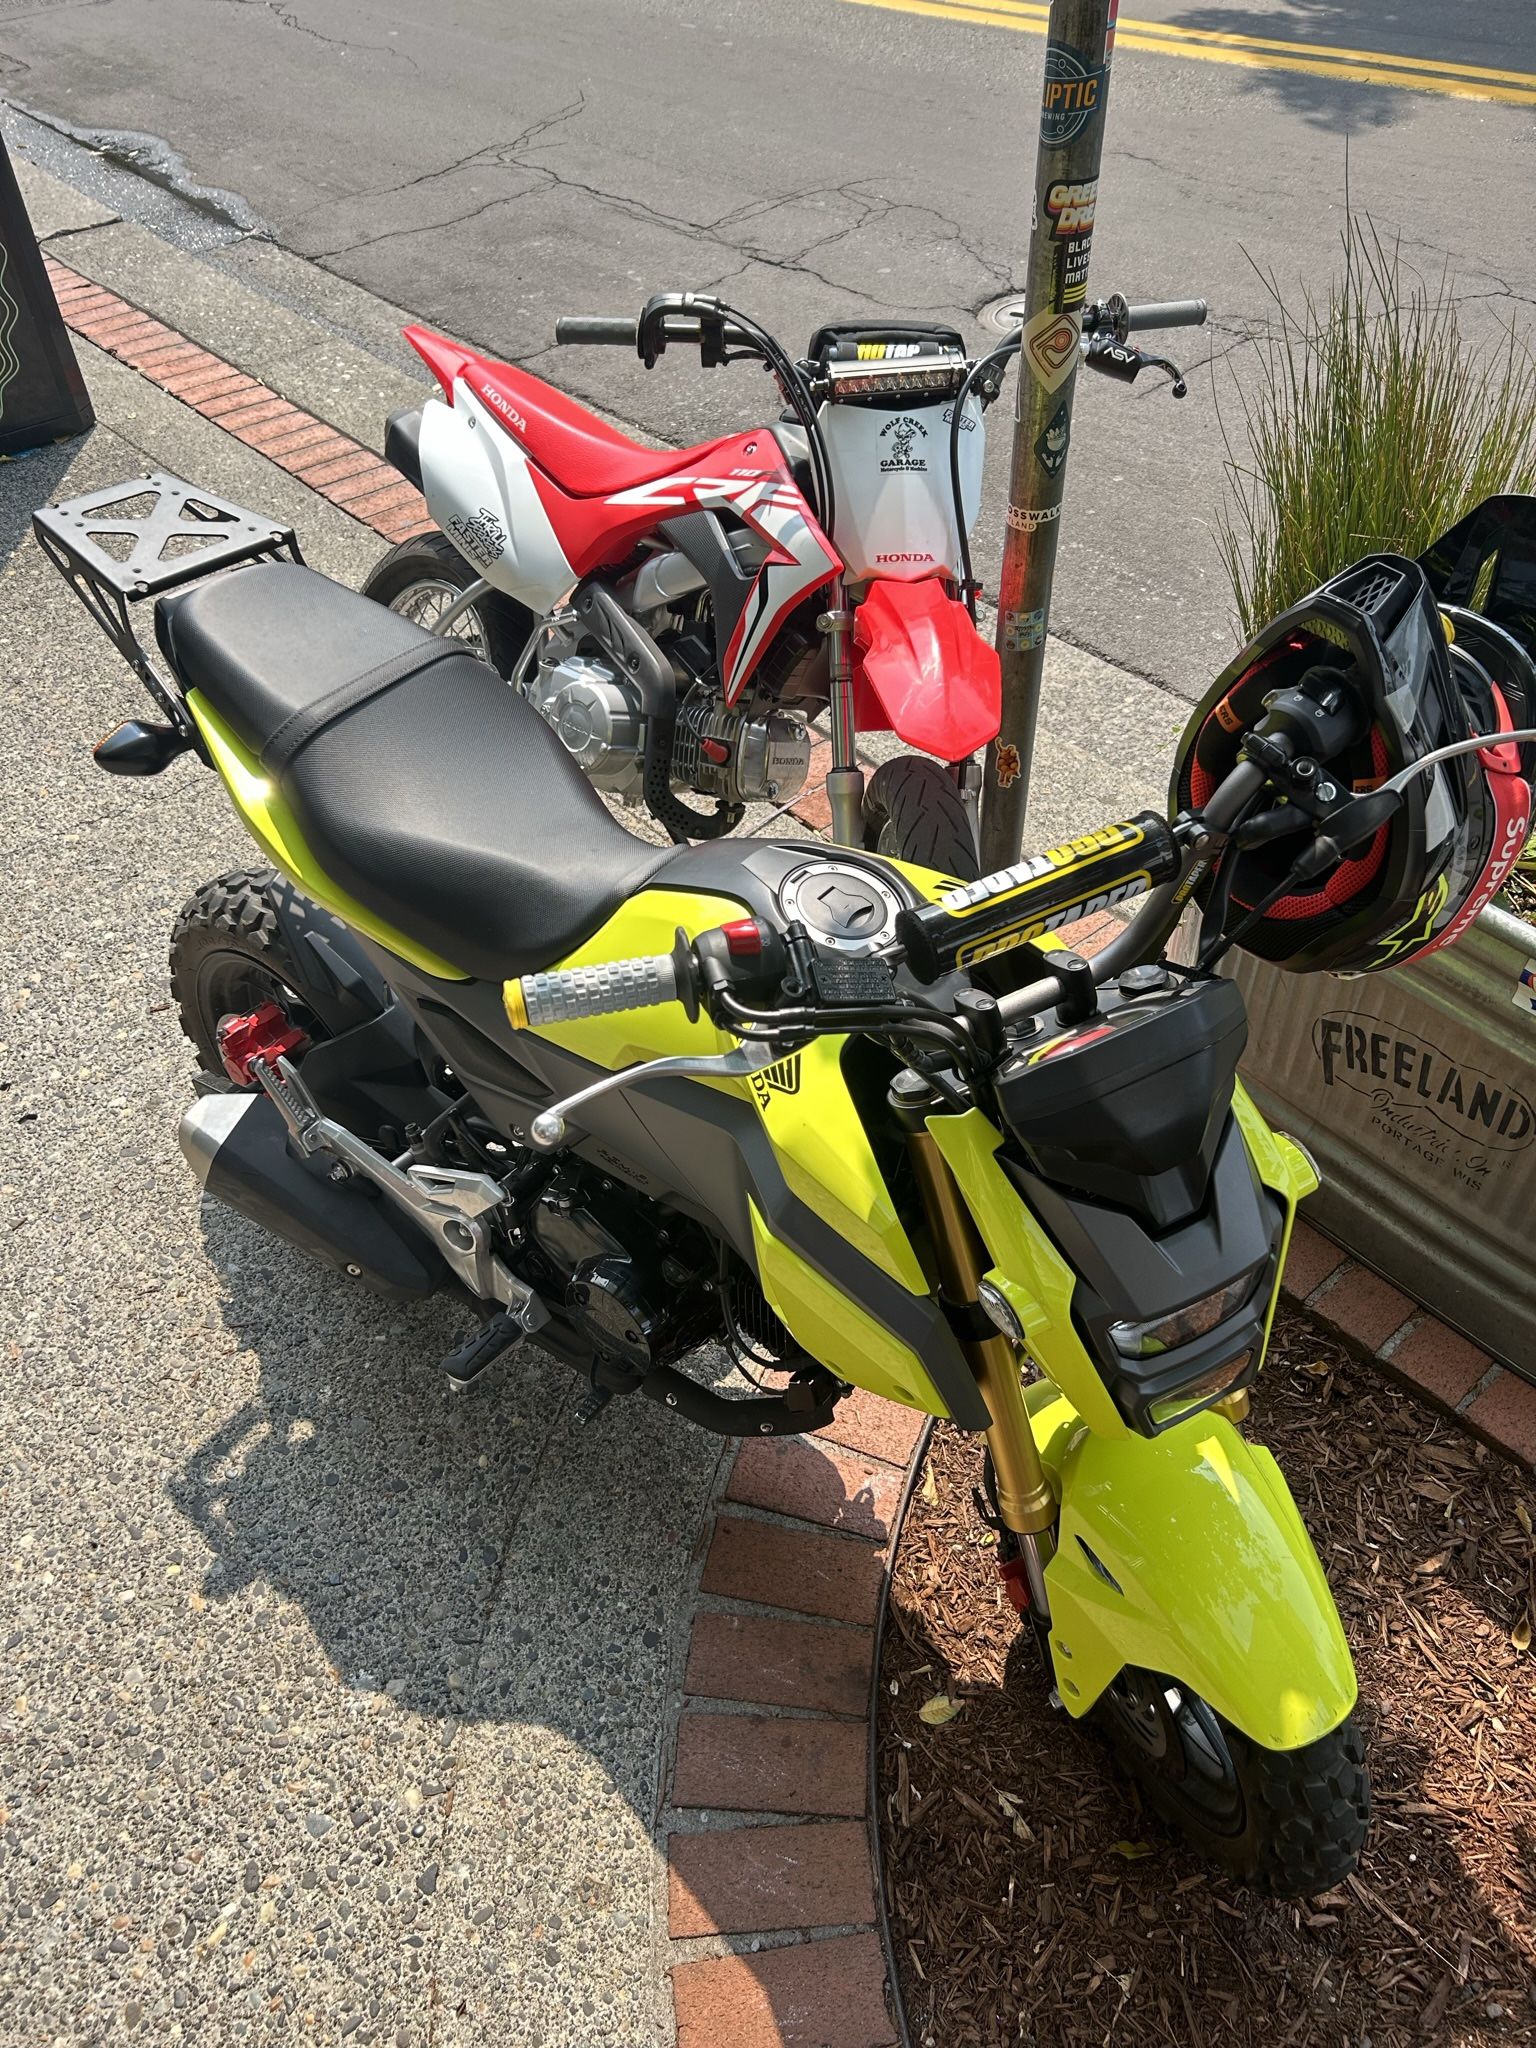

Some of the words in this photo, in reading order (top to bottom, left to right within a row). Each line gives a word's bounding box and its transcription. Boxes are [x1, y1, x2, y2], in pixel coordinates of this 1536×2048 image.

[1068, 237, 1092, 253] BLAC
[1104, 346, 1135, 363] ASV
[481, 383, 527, 434] HONDA
[880, 417, 901, 437] WOLF
[903, 417, 928, 438] CREEK
[880, 459, 926, 467] GARAGE
[1008, 516, 1035, 529] TLAND
[447, 524, 478, 560] MINIS
[449, 514, 493, 566] FASTER
[876, 553, 935, 563] HONDA
[772, 757, 805, 766] HONDA
[1321, 1018, 1531, 1140] FREELAND
[1371, 1115, 1445, 1166] PORTAGE
